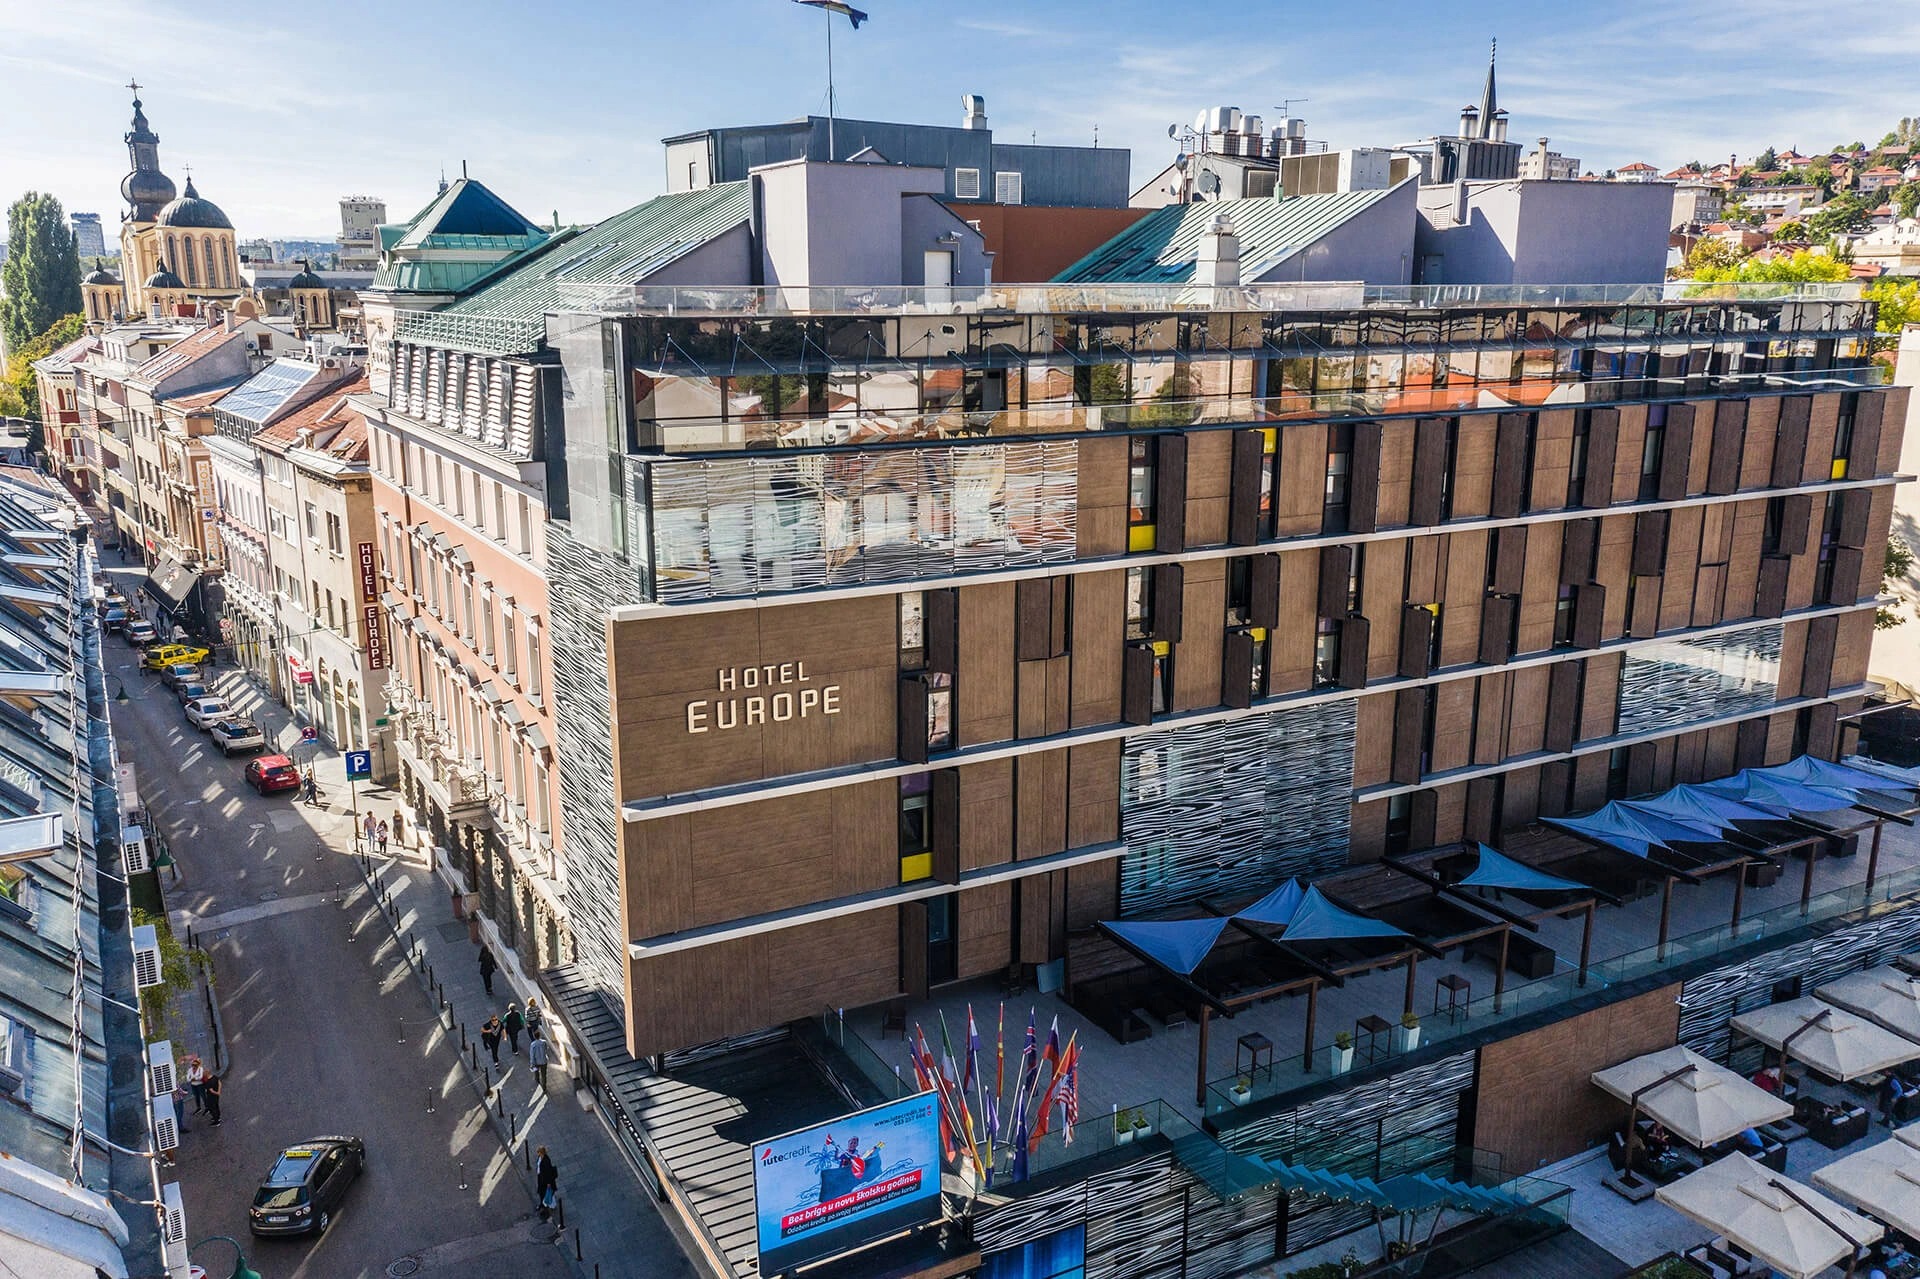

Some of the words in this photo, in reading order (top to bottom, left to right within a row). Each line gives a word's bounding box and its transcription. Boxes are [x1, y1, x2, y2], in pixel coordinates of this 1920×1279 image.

[199, 464, 211, 505] HOTEL
[361, 544, 374, 595] HOTEL
[367, 608, 381, 668] EUROPE
[718, 661, 810, 692] HOTEL
[686, 685, 841, 734] EUROPE
[354, 756, 365, 772] P
[762, 1145, 810, 1166] iutecredit
[788, 1214, 803, 1225] Bez
[805, 1207, 826, 1218] brige
[835, 1197, 854, 1208] novu
[887, 1175, 917, 1191] godinu.
